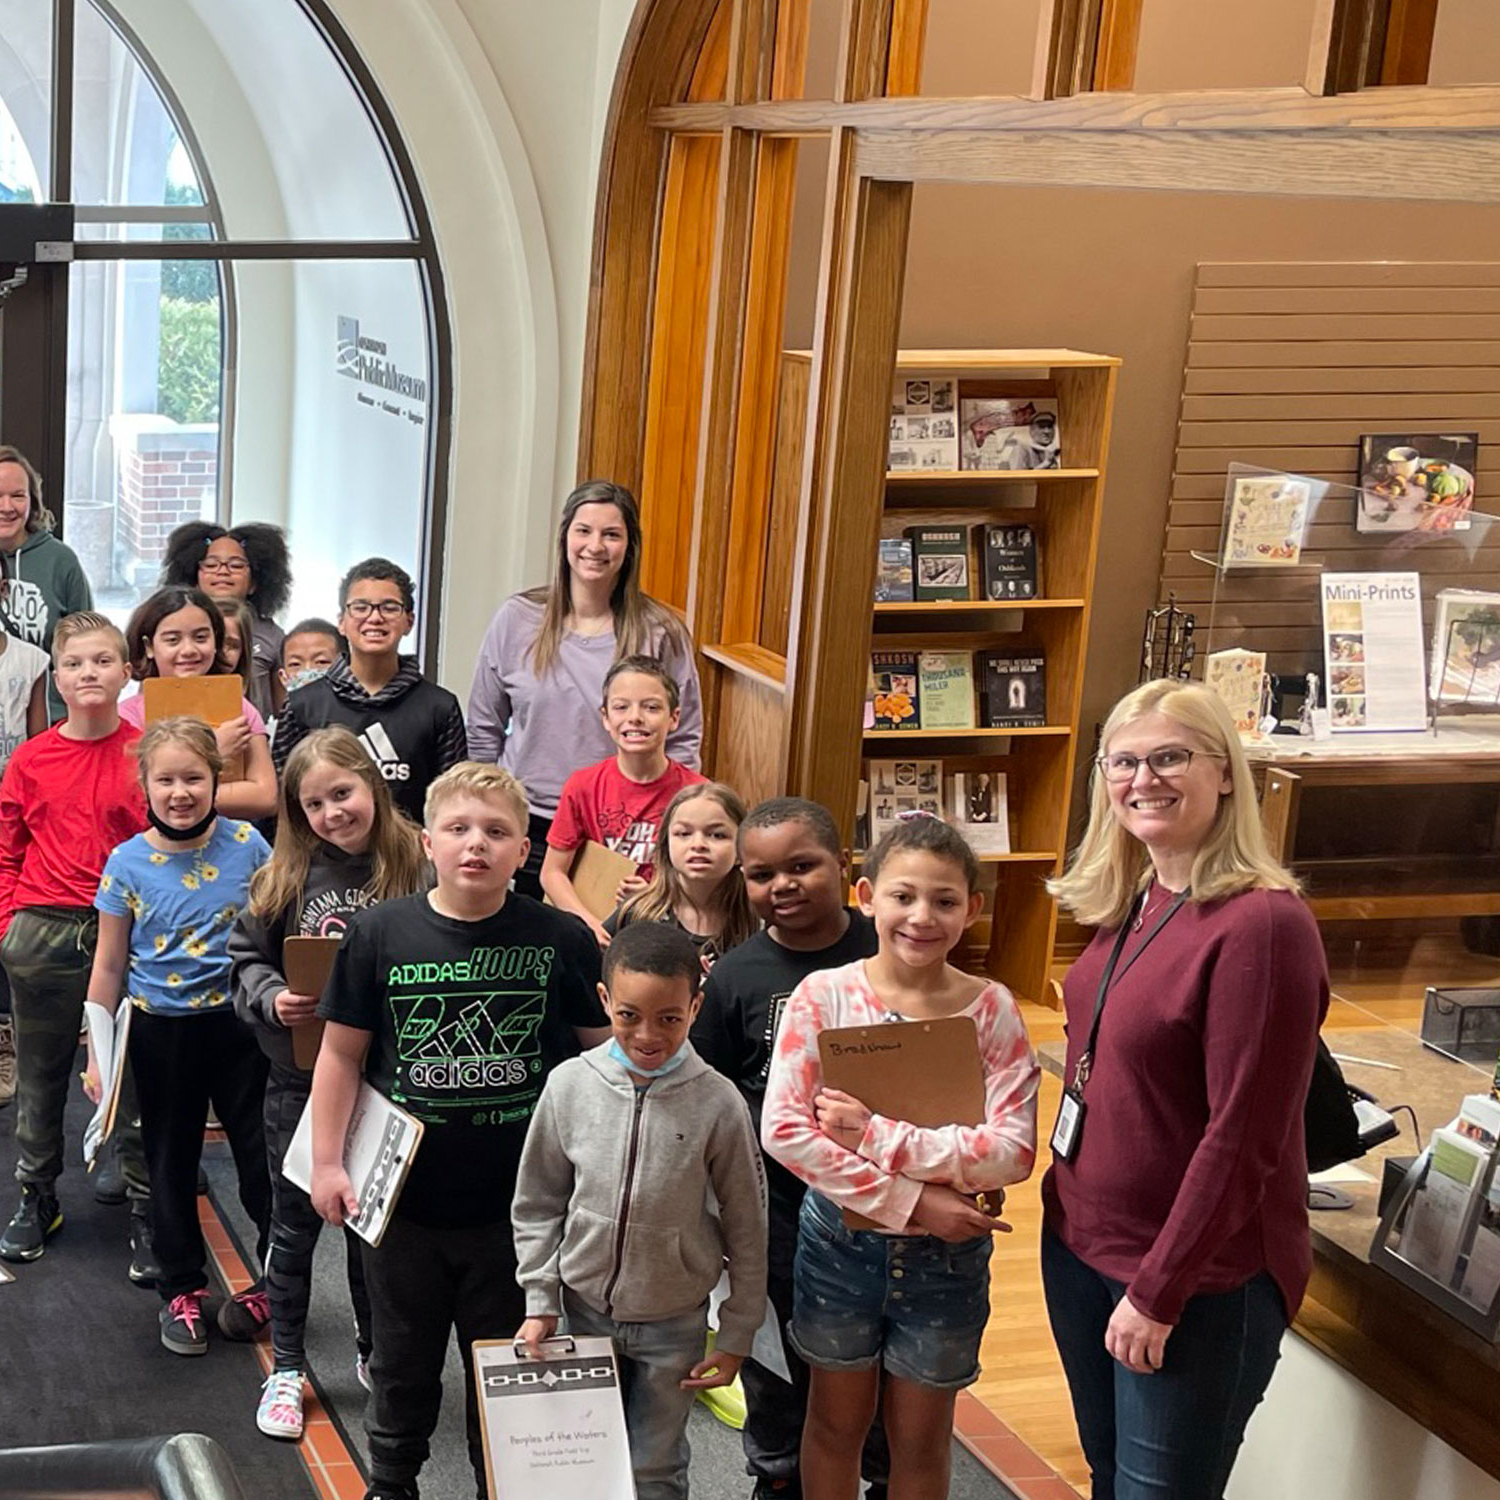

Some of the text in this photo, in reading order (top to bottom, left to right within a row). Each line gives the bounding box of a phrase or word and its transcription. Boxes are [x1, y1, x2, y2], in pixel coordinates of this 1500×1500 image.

[1325, 584, 1416, 600] Mini-Prints
[625, 820, 656, 842] OH
[388, 962, 471, 986] ADIDAS
[468, 945, 556, 981] HOOPS
[408, 1055, 528, 1089] adidas
[545, 1431, 555, 1441] of
[557, 1431, 571, 1440] the
